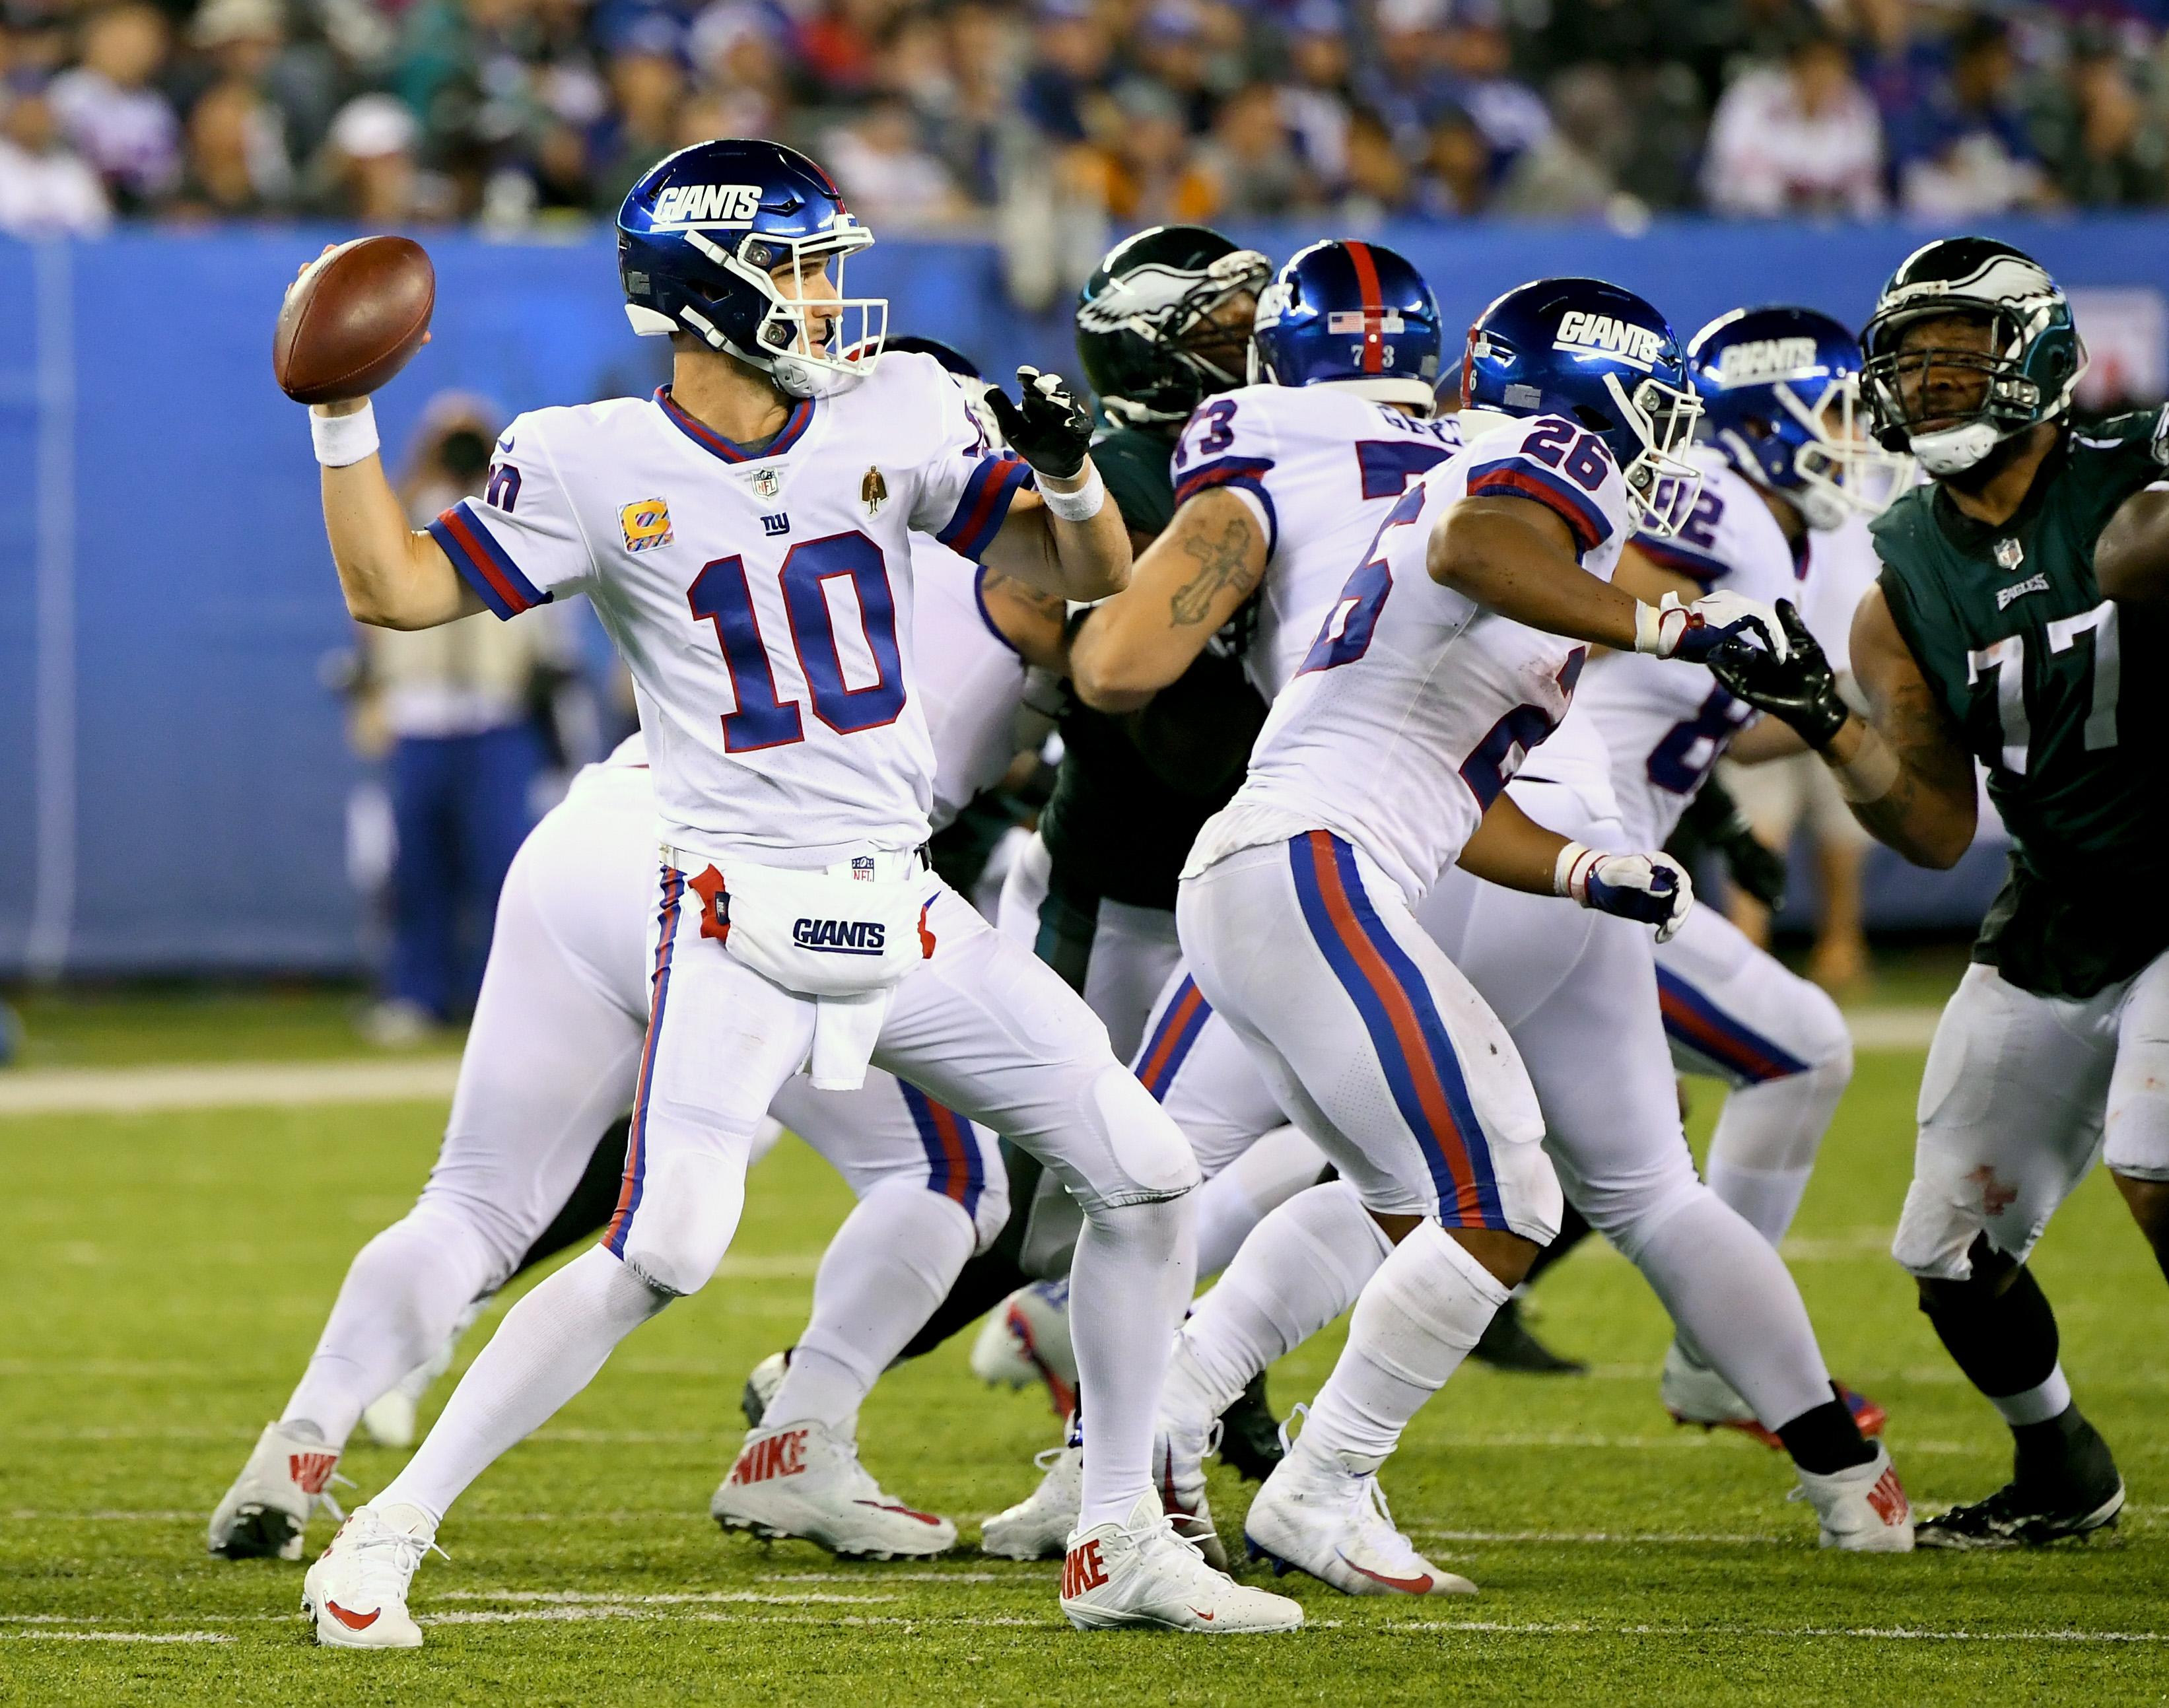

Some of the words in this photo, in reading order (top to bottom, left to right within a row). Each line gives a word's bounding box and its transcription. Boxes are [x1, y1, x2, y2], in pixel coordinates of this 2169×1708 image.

[653, 185, 763, 222] GIANTS
[1556, 310, 1663, 362] GIANTS
[1519, 419, 1612, 492] 26
[757, 479, 776, 494] NFL
[686, 529, 907, 753] 10
[1967, 599, 2121, 776] 77
[853, 870, 872, 882] NFL
[792, 918, 885, 949] GIANTS
[731, 1429, 809, 1486] NIKE
